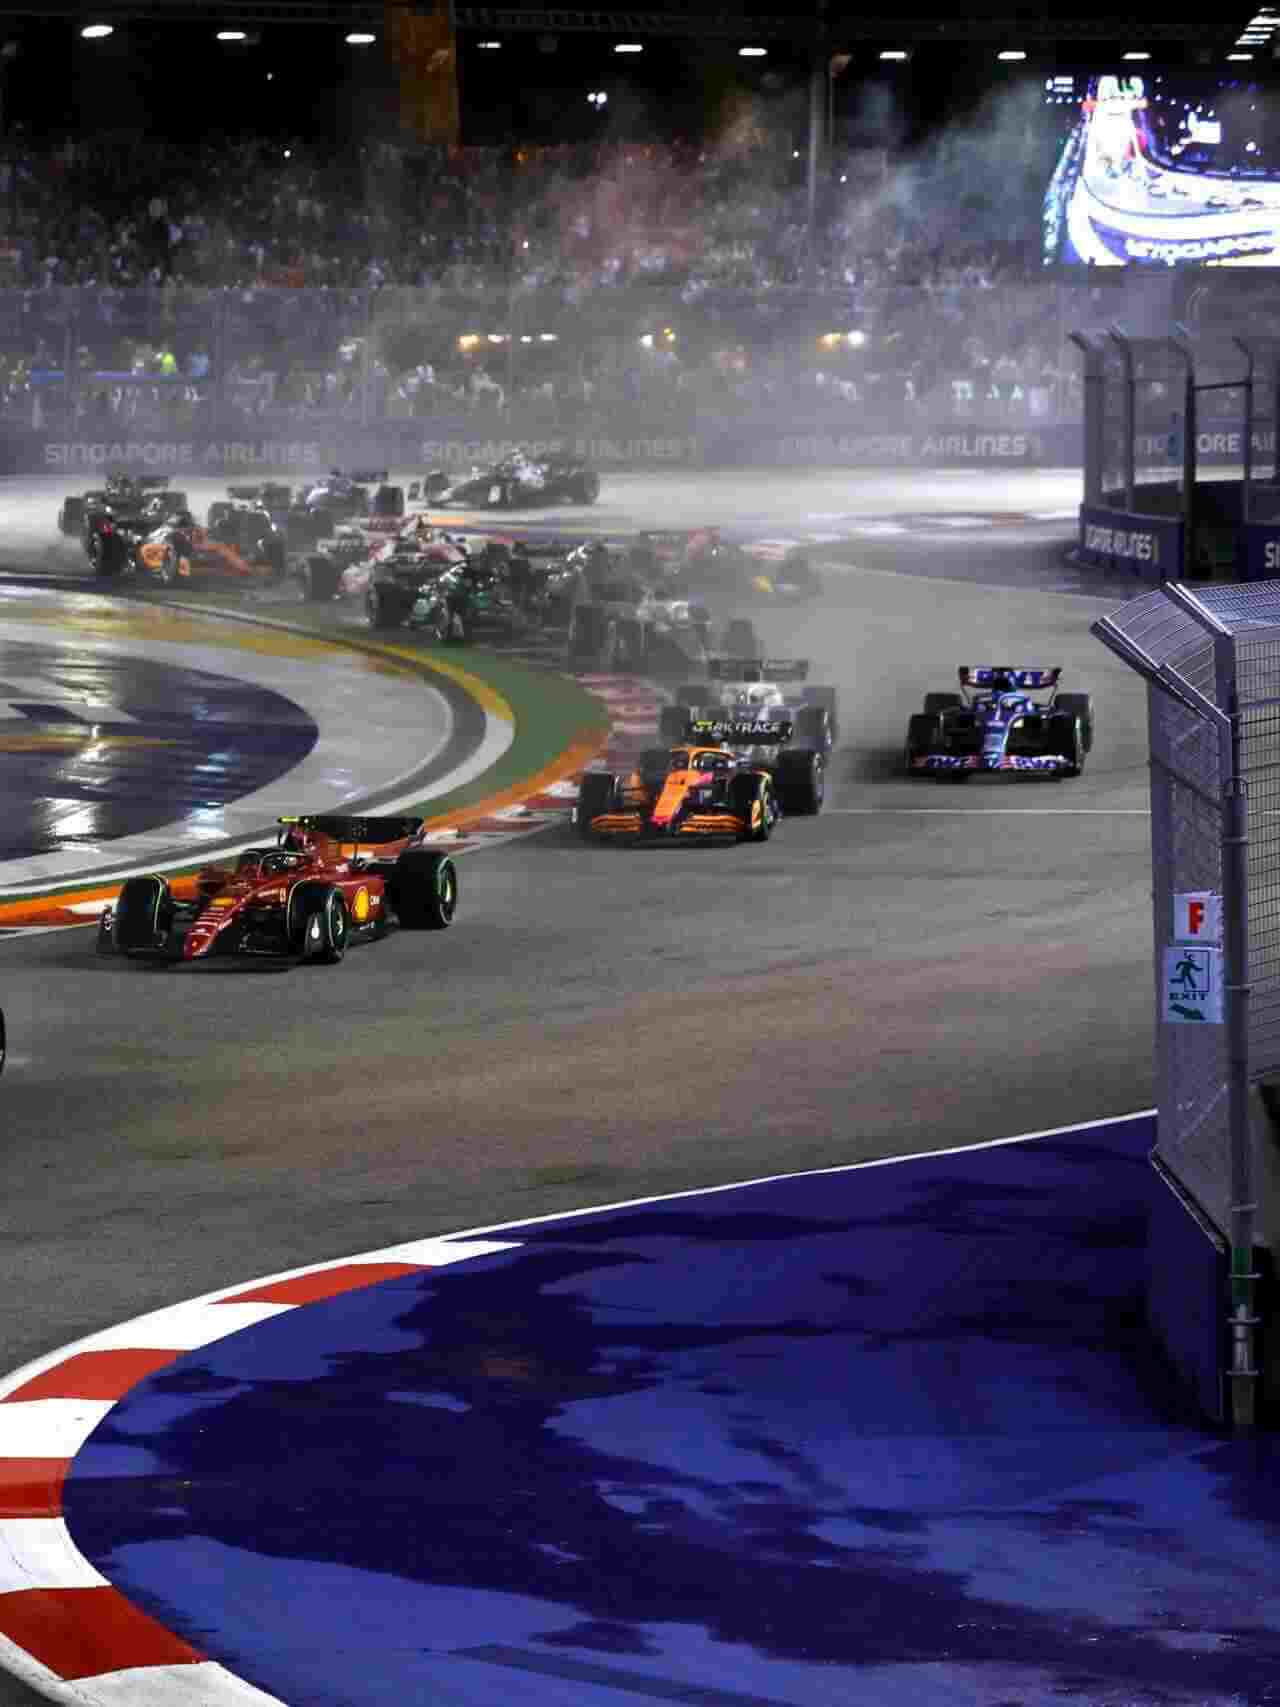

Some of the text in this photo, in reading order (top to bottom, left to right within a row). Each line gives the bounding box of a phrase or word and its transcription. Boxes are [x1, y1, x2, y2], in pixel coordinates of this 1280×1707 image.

[44, 441, 318, 465] SINGAPORE AIRLINES
[920, 434, 1026, 457] AIRLINES
[1188, 901, 1205, 935] F
[1168, 991, 1209, 1001] EXIT
